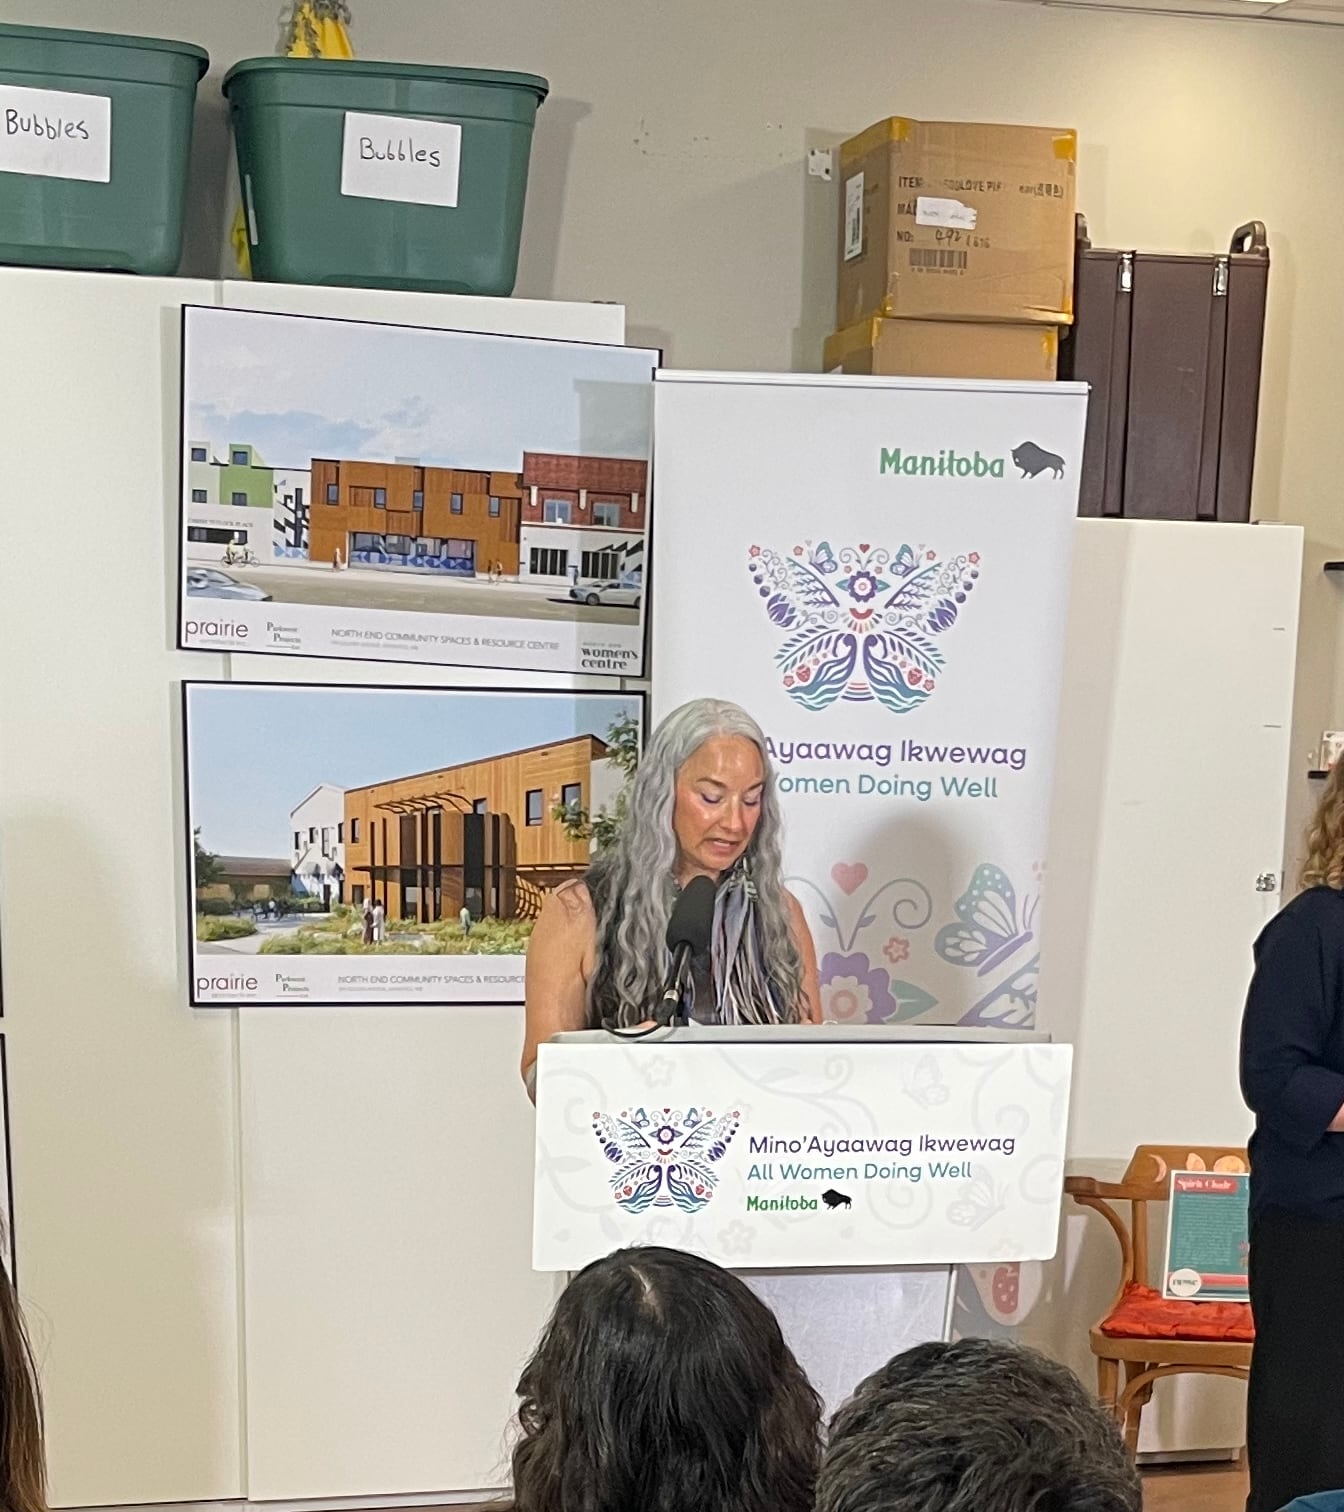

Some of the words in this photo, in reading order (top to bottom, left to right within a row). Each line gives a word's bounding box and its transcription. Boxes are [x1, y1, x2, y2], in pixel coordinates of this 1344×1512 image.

[5, 108, 90, 140] Bubbles
[359, 136, 442, 168] Bubbles
[879, 447, 1005, 479] Manitoba
[185, 618, 249, 643] prairie
[331, 629, 362, 639] NORTH
[364, 630, 383, 640] END
[385, 632, 438, 644] COMMUNITY
[441, 636, 471, 646] SPACES
[473, 638, 480, 646] &
[482, 638, 526, 650] RESOURCE
[528, 641, 560, 651] CENTRE
[581, 647, 638, 660] women's
[581, 658, 628, 669] centre
[900, 739, 1028, 770] Ikwewag
[857, 775, 933, 802] Doing
[939, 776, 999, 799] Well
[196, 973, 259, 998] prairie
[338, 976, 368, 985] NORTH
[369, 976, 388, 985] END
[390, 976, 442, 985] COMMUNITY
[443, 976, 475, 985] SPACES
[476, 976, 482, 985] &
[748, 1134, 913, 1157] Mino'Ayaawag
[918, 1134, 1016, 1156] Ikwewag
[747, 1162, 774, 1181] All
[778, 1162, 858, 1181] Women
[863, 1161, 923, 1183] Doing
[927, 1161, 972, 1180] Well
[746, 1194, 819, 1213] Manitoba
